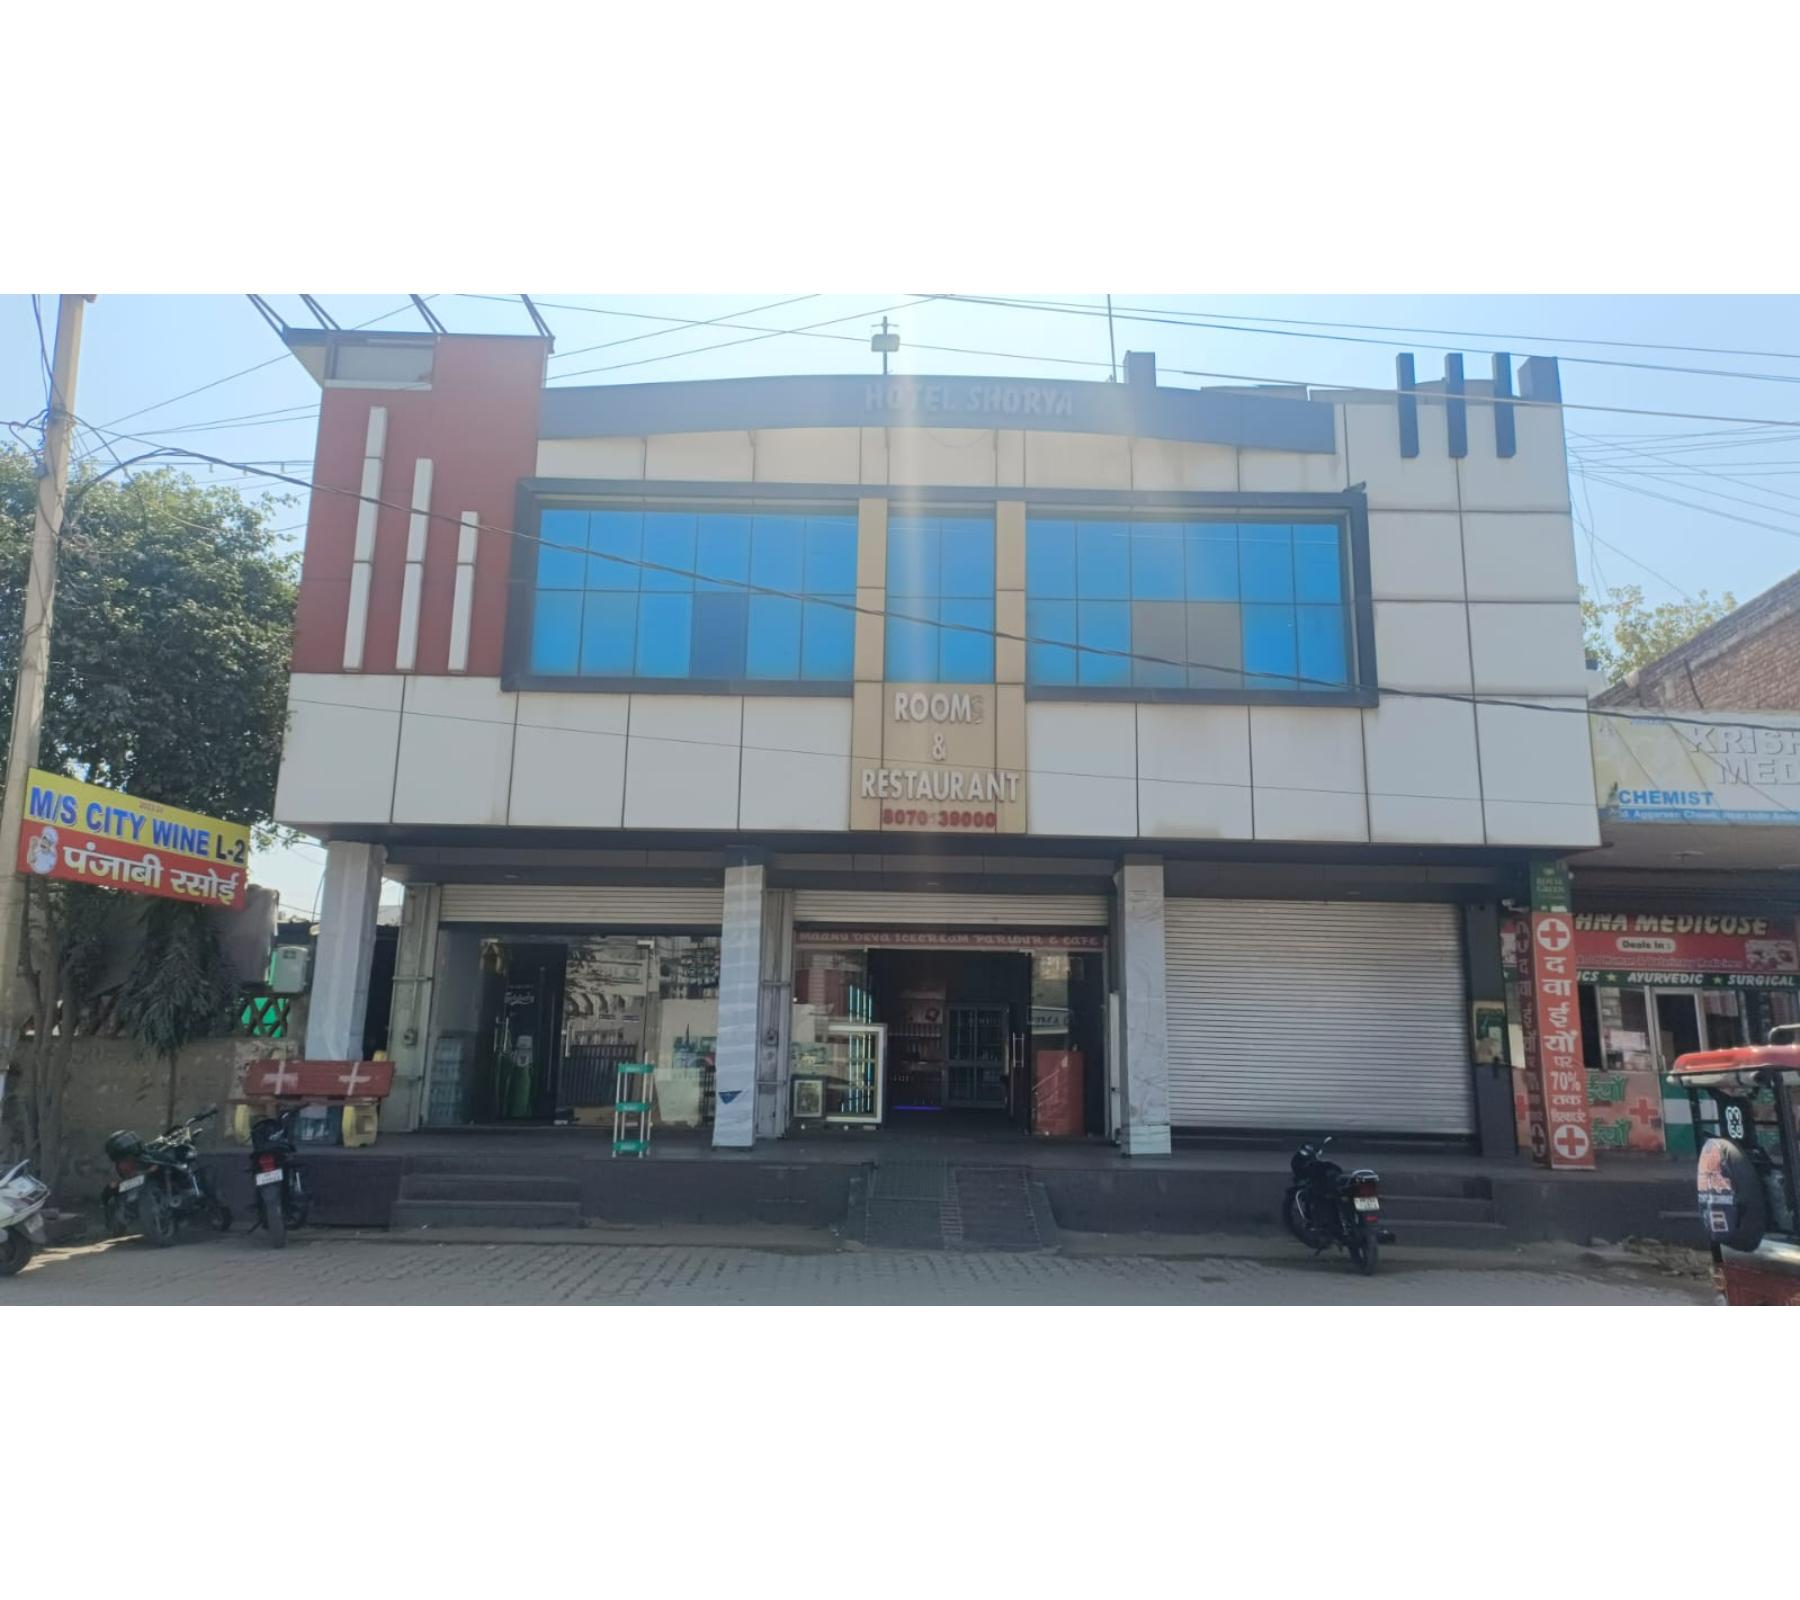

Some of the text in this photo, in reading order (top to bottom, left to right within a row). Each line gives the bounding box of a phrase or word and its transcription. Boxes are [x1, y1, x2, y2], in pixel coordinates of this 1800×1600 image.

[865, 383, 956, 413] HOTEL
[931, 733, 946, 761] &
[862, 768, 1020, 803] RESTAURANT
[1618, 789, 1714, 806] CHEMIST
[30, 787, 246, 864] M/S CITY WINE L-2
[63, 842, 239, 906] पंजाबी रसोई
[1627, 972, 1704, 984] AYURVEDIC
[1727, 974, 1794, 986] SURGICAL
[1550, 1071, 1581, 1092] 70%
